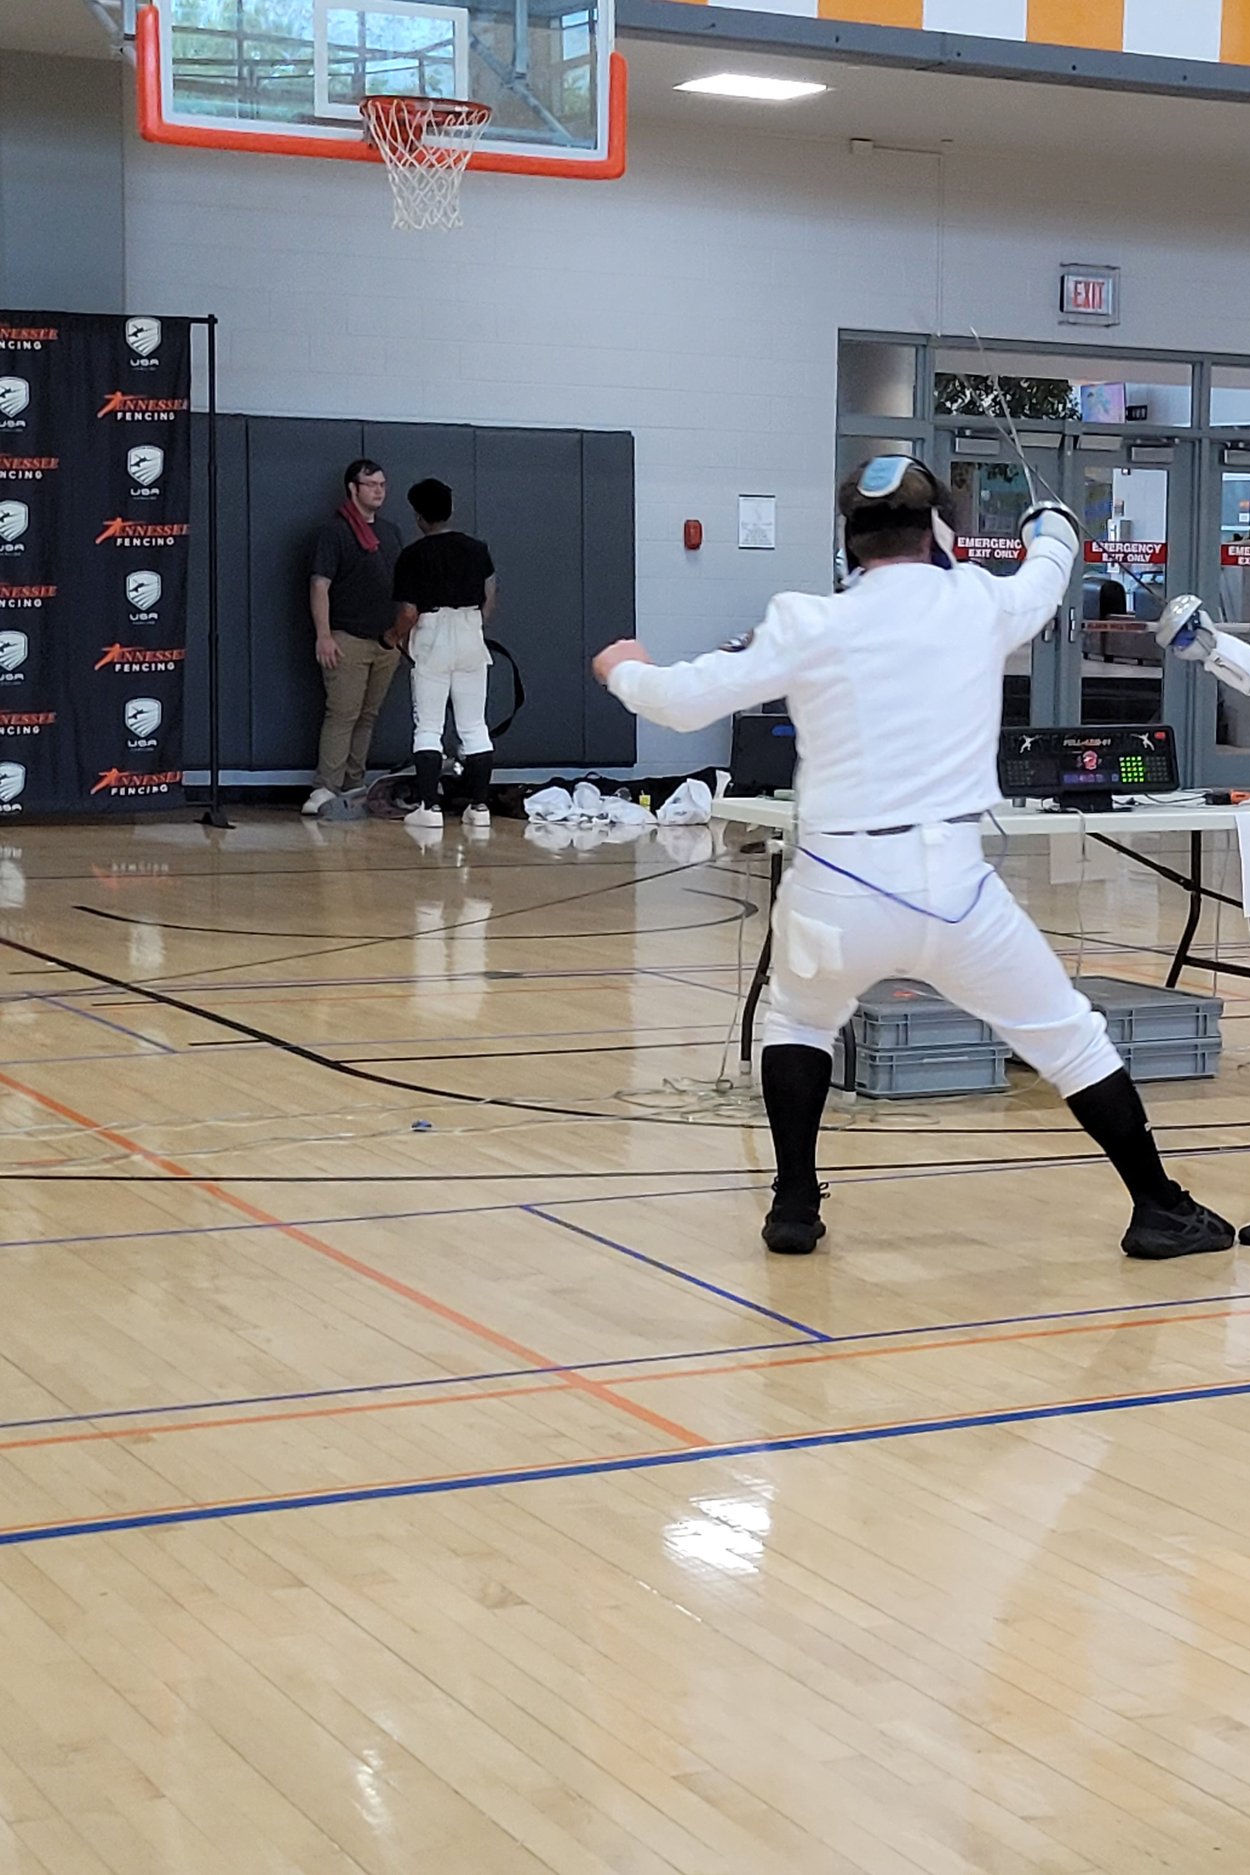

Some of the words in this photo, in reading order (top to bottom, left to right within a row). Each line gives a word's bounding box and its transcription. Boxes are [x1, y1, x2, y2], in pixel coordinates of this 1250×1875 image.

[1072, 280, 1104, 309] EXIT
[130, 358, 159, 366] USA
[117, 412, 175, 421] FENCING
[130, 488, 160, 496] USA
[116, 537, 175, 547] FENCING
[957, 537, 1022, 549] EMERGENC
[1091, 542, 1163, 554] EMERGENCY
[968, 549, 991, 558] EXIT
[994, 550, 1020, 559] ONLY
[1127, 553, 1151, 563] ONLY
[129, 613, 158, 621] USA
[115, 662, 176, 672] FENCING
[127, 739, 157, 748] USA
[111, 784, 168, 796] FENCING
